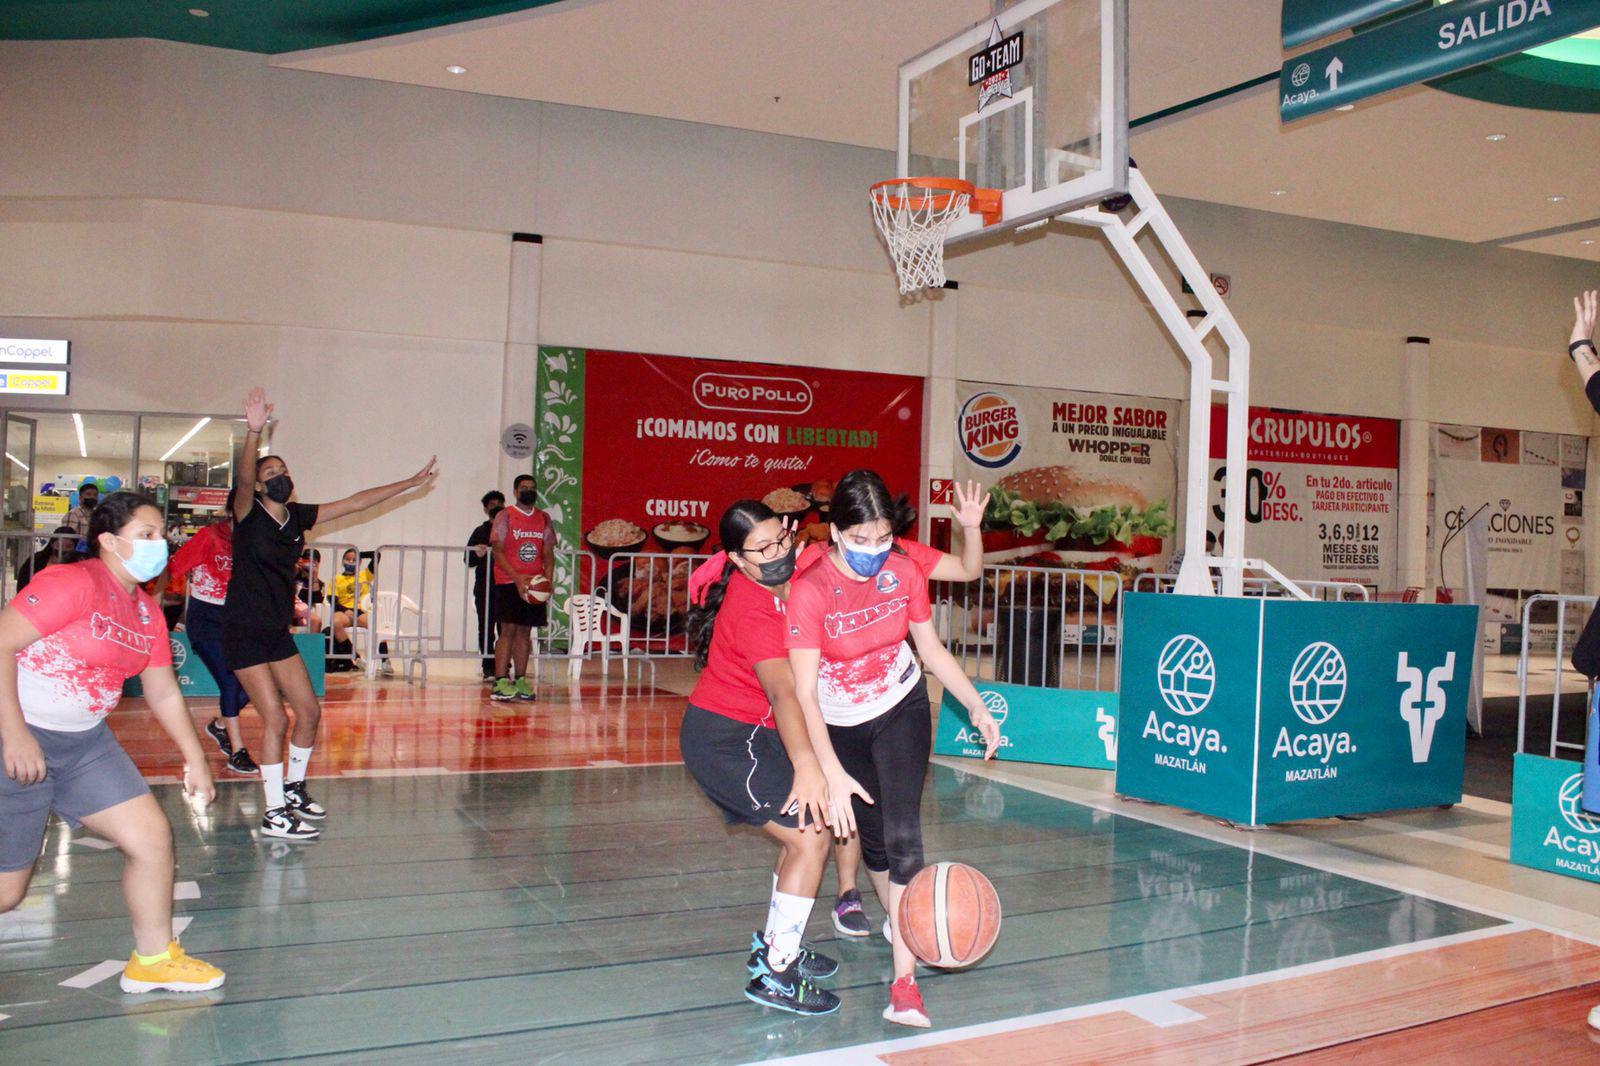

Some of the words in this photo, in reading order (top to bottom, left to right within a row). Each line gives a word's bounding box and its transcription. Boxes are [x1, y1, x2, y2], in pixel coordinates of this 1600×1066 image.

[1438, 0, 1551, 49] SALIDA
[971, 56, 986, 82] GO
[990, 36, 1020, 72] TEAM
[1282, 88, 1319, 107] Acaya.
[701, 382, 750, 400] PURO
[752, 386, 807, 402] POLLO
[965, 407, 1017, 432] BURGER
[1052, 402, 1107, 424] MEJOR
[1113, 407, 1167, 428] SABOR
[637, 418, 737, 441] ¡COMAMOS
[744, 424, 779, 443] CON
[787, 427, 878, 449] LIBERTAD!
[967, 420, 1019, 451] KING
[1052, 422, 1059, 433] A
[1062, 423, 1075, 434] UN
[1078, 425, 1109, 436] PRECIO
[1112, 427, 1167, 440] INIGUALABLE
[1248, 417, 1361, 449] CRUPULOS
[1068, 439, 1151, 457] WHOPPER
[689, 449, 740, 468] ¡Como
[743, 453, 760, 468] te
[764, 456, 813, 473] gusta!
[1099, 455, 1119, 463] DOBLE
[1133, 457, 1151, 465] QUESO
[1306, 475, 1318, 487] En
[1320, 477, 1331, 488] tu
[1333, 476, 1354, 489] 2do.
[1315, 490, 1335, 500] PAGO
[1336, 491, 1345, 500] EN
[1347, 492, 1378, 502] EFECTIVO
[645, 498, 710, 517] CRUSTY
[1262, 502, 1303, 522] DESC.
[1312, 501, 1340, 511] TARJETA
[1341, 502, 1389, 513] PARTICIPANTE
[1362, 525, 1379, 541] 12
[1322, 543, 1358, 554] MESES
[1360, 545, 1379, 554] SIN
[1322, 554, 1379, 565] INTERESES
[954, 727, 1014, 747] Acaa.
[1142, 710, 1228, 757] Acaya.
[1272, 726, 1357, 764] Acaya.
[1154, 752, 1207, 774] MAZATLÁN
[1285, 765, 1338, 782] MAZATLÁN
